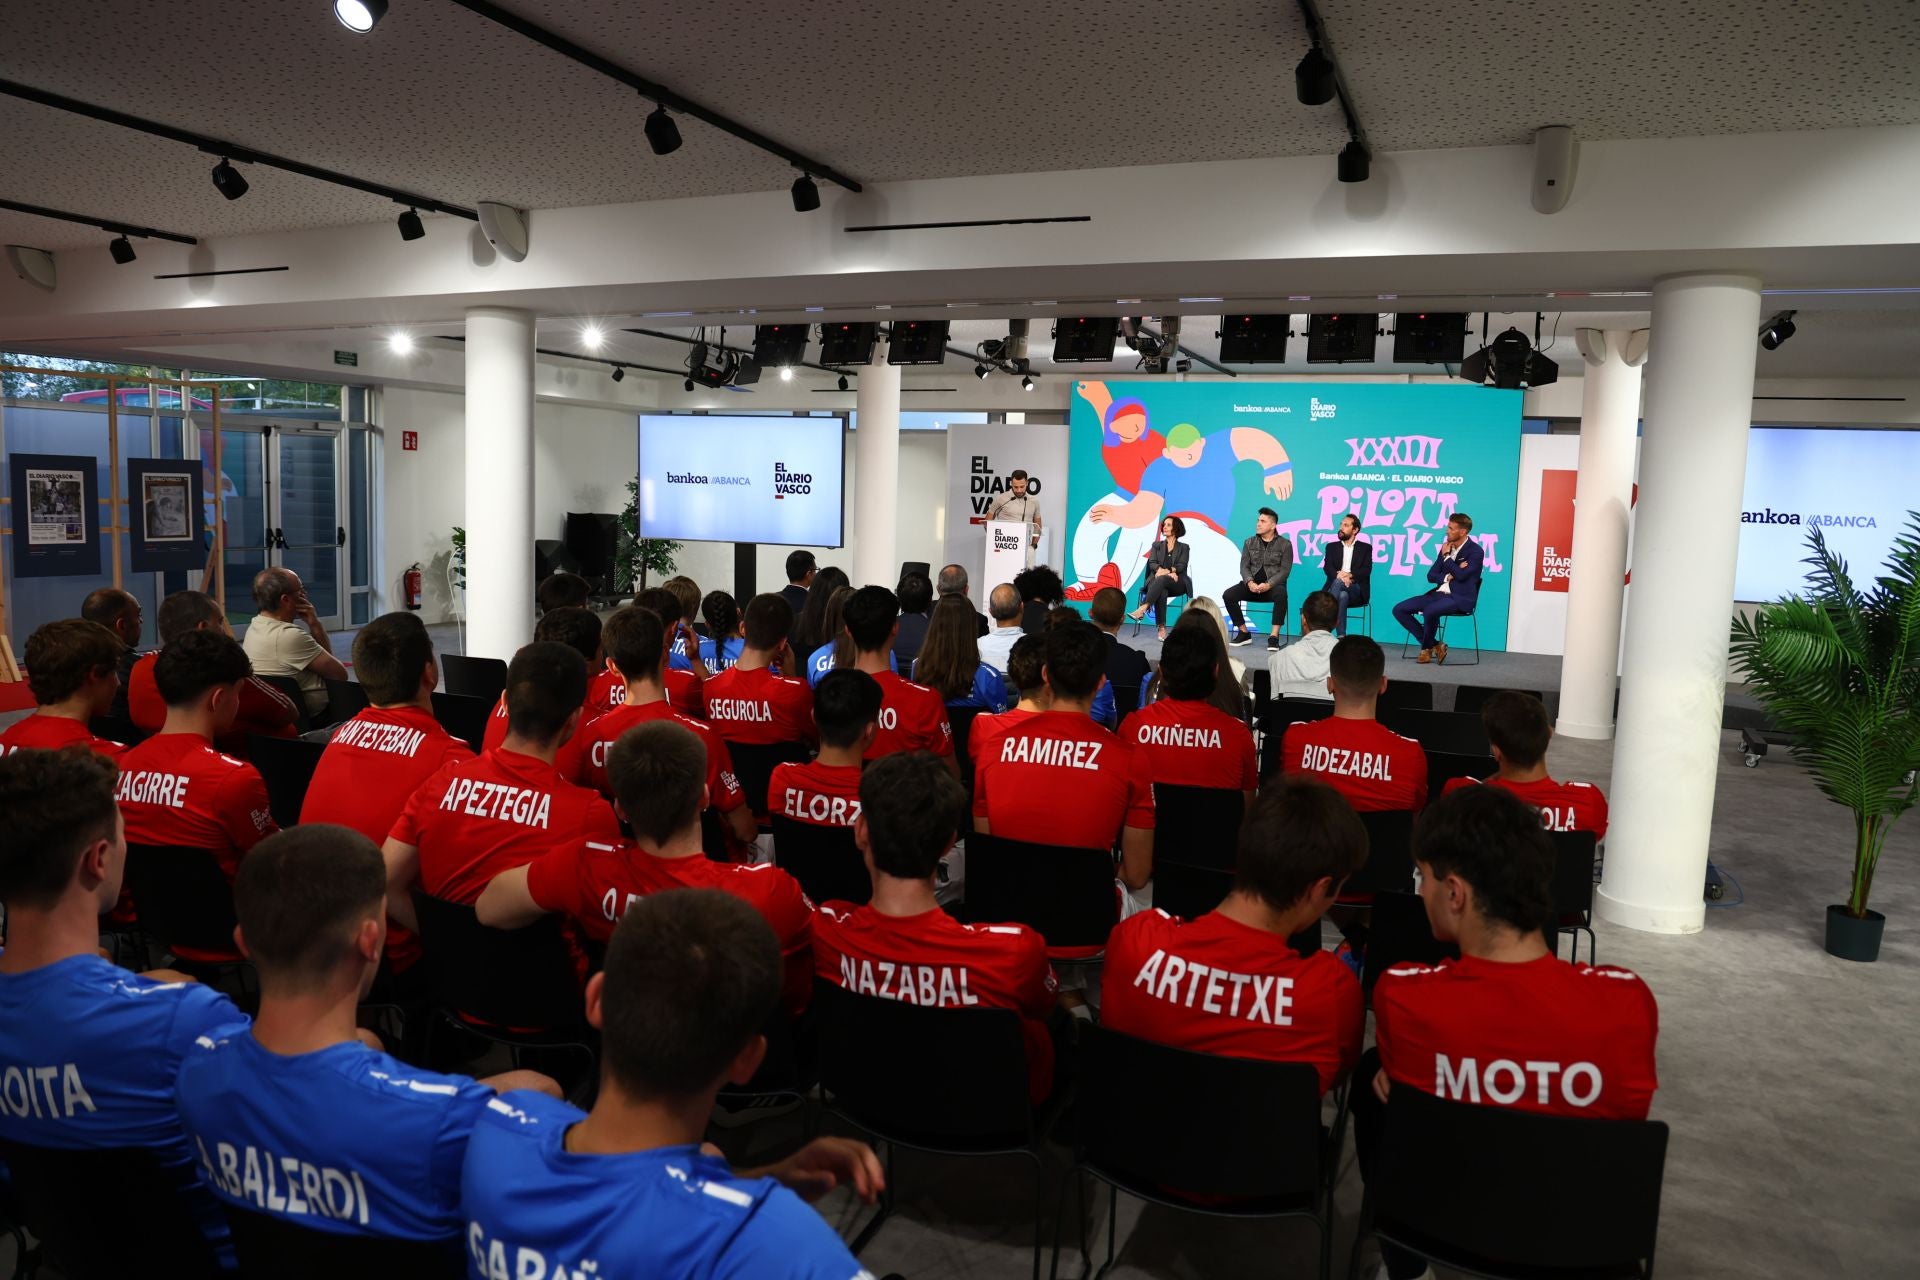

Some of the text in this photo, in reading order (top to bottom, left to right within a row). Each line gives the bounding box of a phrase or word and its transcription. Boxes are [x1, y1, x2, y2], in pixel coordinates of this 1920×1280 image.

[1344, 434, 1444, 468] XXXIII
[774, 462, 788, 473] EL
[971, 455, 994, 474] EL
[666, 472, 708, 484] bankoa
[774, 473, 812, 484] DIARIO
[970, 476, 1042, 496] DIAO
[1319, 472, 1464, 485] Bankoa ABANCA EL DIARIO VASCO
[775, 484, 811, 495] VASCO
[1741, 508, 1801, 525] ankoa
[994, 535, 1019, 543] DIARIO
[994, 542, 1018, 550] VASCO
[1543, 547, 1558, 557] EL
[1542, 557, 1573, 568] DIAR
[1542, 567, 1572, 578] VASC
[709, 698, 773, 722] SEGUROLA
[1137, 723, 1222, 748] OKIÑENA
[1000, 736, 1103, 771] RAMIREZ
[1301, 743, 1392, 782] BIDEZABAL
[439, 777, 551, 830] APEZTEGIA
[784, 787, 863, 826] ELORZ
[840, 953, 979, 1007] NAZABAL
[1133, 949, 1295, 1027] ARTETXE
[1434, 1053, 1603, 1107] MOTO
[0, 1063, 97, 1119] OITA
